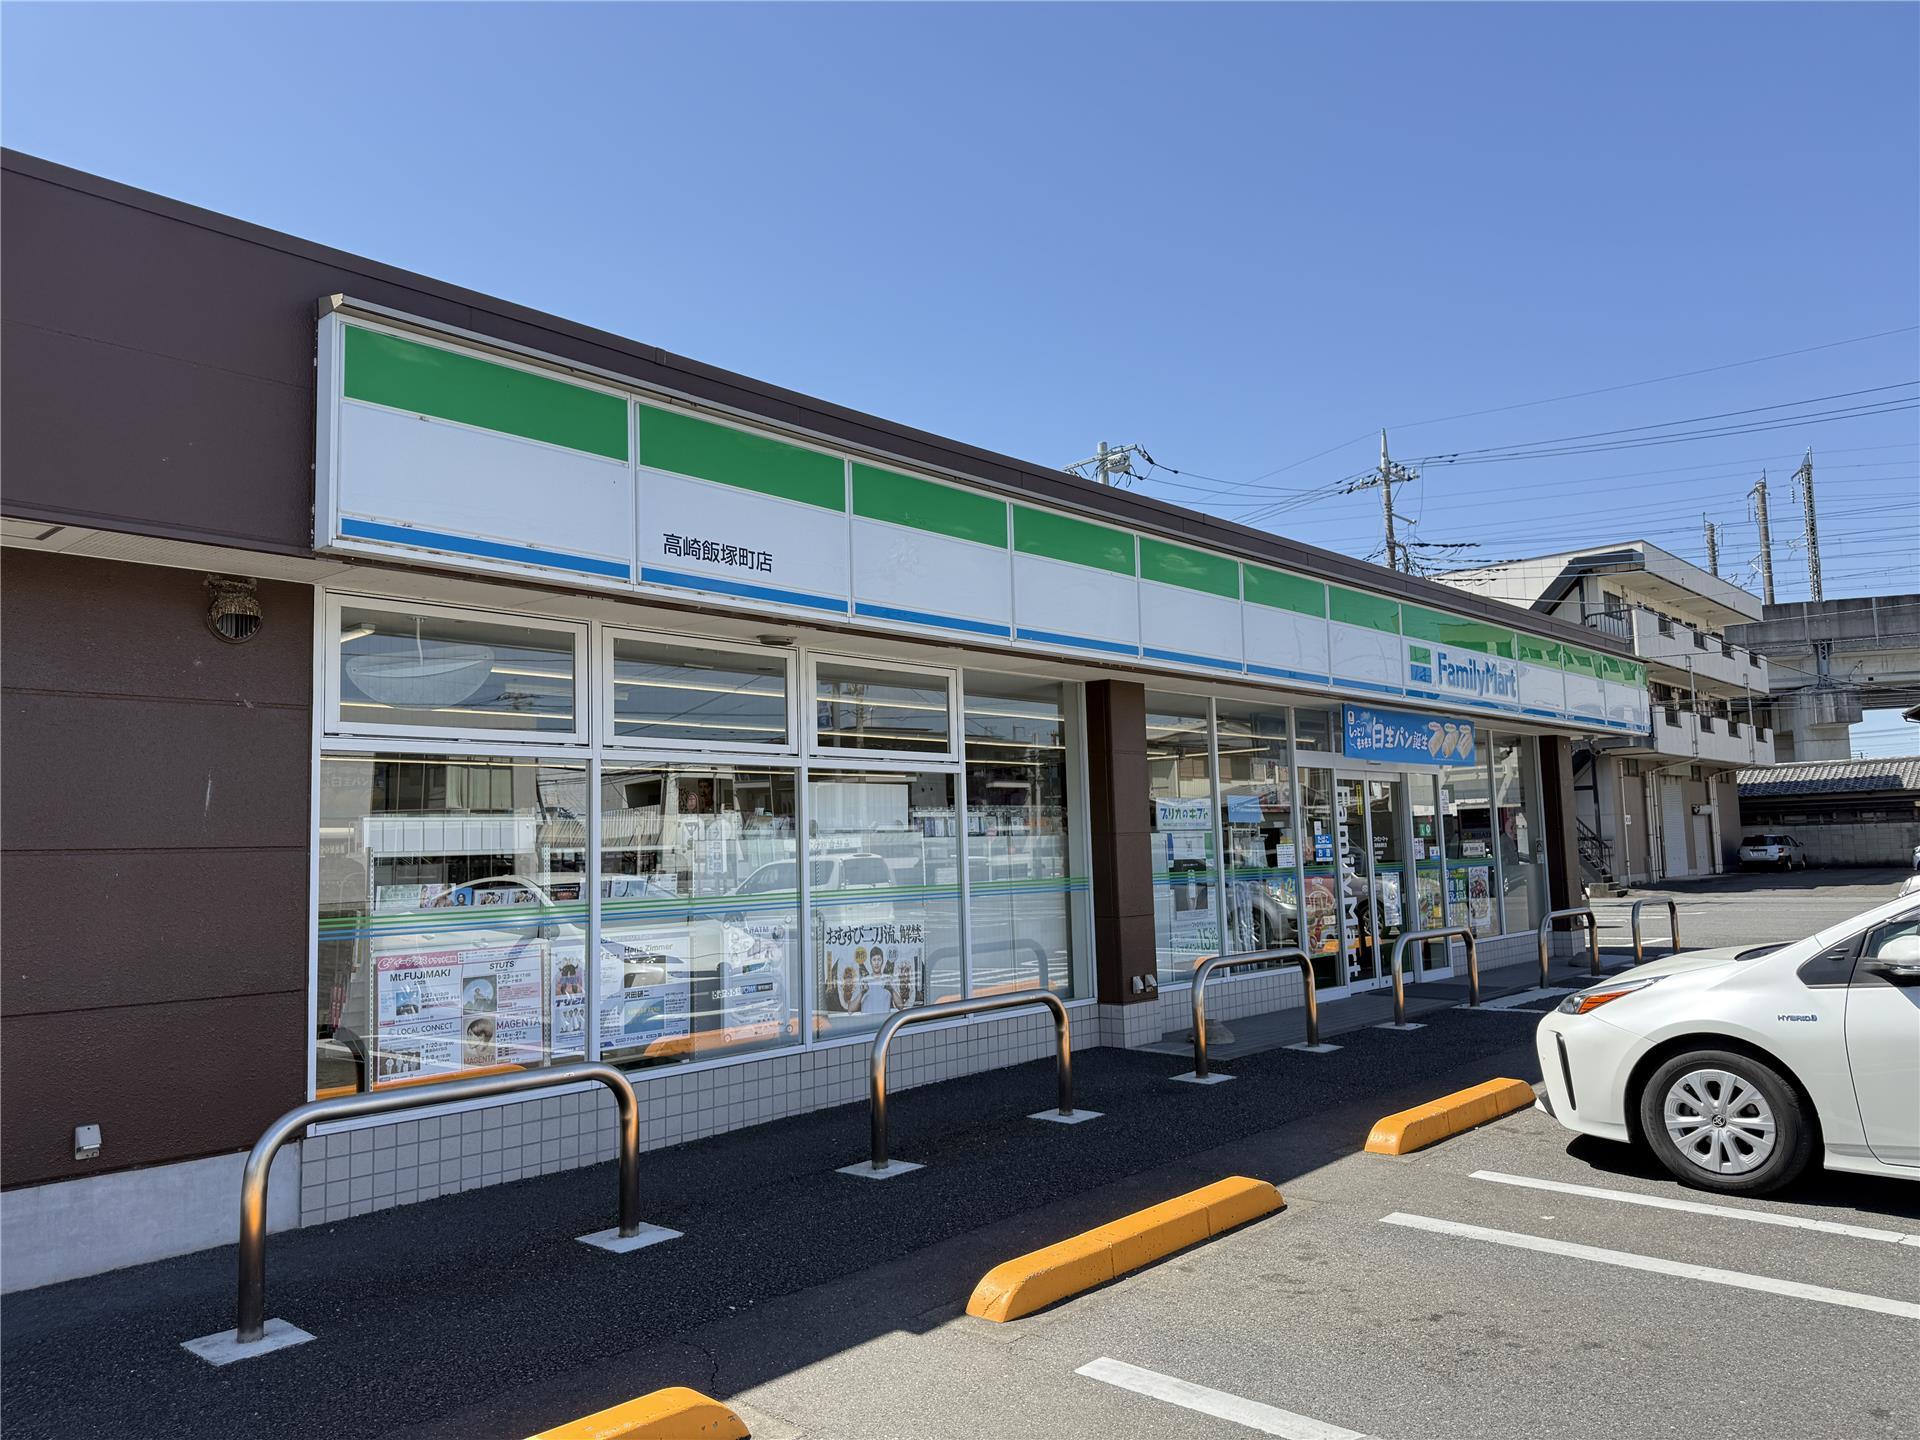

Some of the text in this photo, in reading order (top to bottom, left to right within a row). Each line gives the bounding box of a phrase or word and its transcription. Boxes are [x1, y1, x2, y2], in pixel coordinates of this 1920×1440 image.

[662, 533, 773, 573] 高崎飯塚町店
[1437, 651, 1517, 698] FamilyMart
[1337, 786, 1362, 977] FamilyMart
[825, 924, 925, 946] おむすび二刀流、解禁。
[645, 943, 673, 952] Zimmer
[489, 960, 515, 970] STUTS
[389, 968, 451, 983] Mt.FUJIMAKI
[396, 1022, 453, 1035] LOCAL CONNECT
[496, 1017, 541, 1030] MAGENTA
